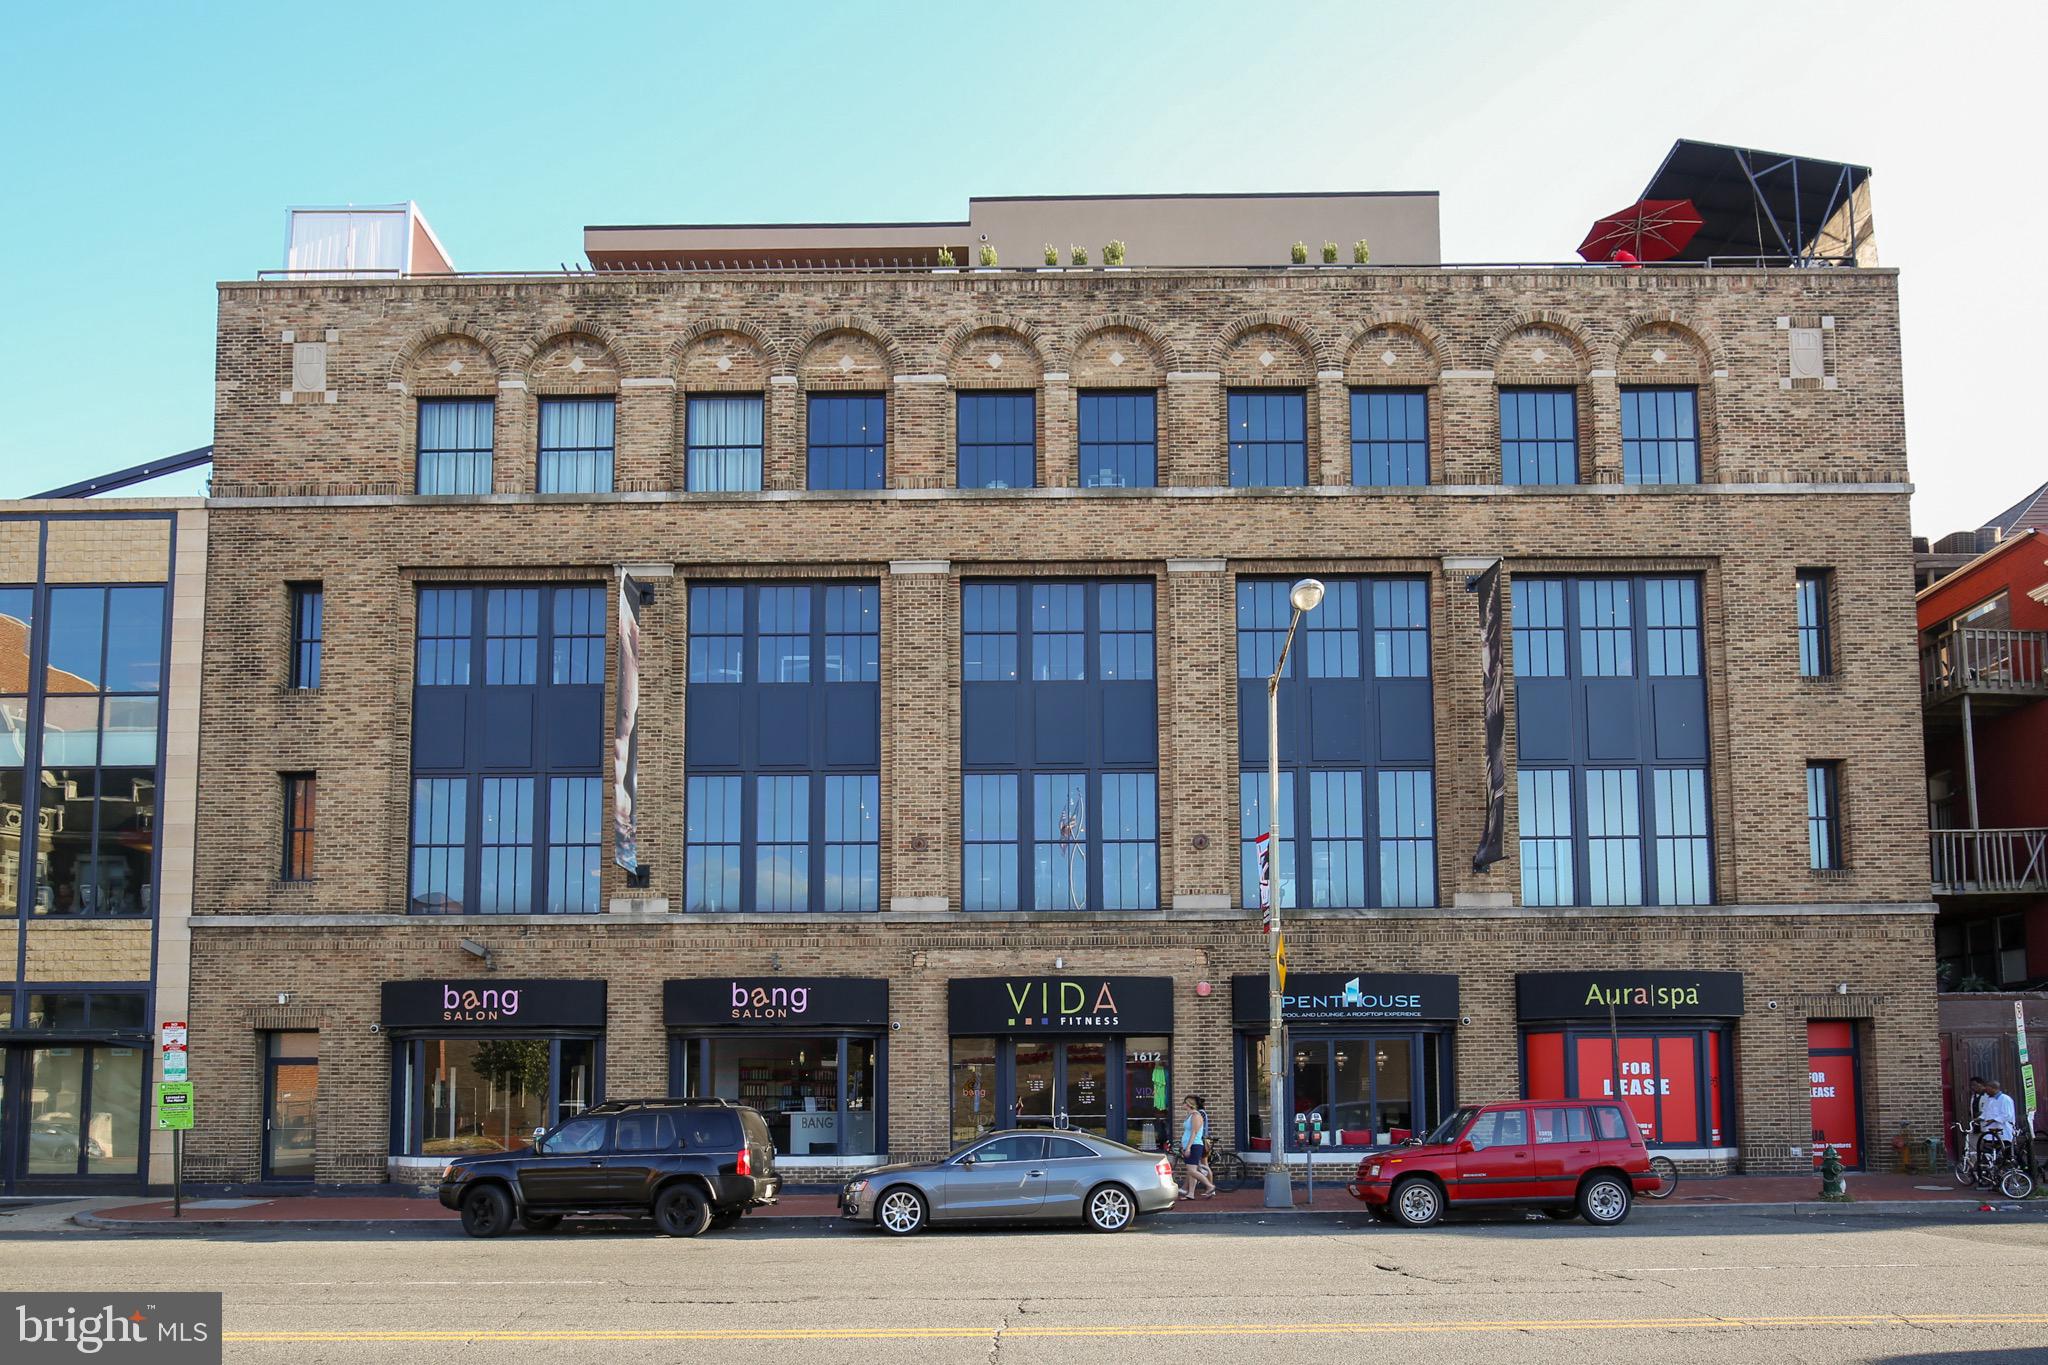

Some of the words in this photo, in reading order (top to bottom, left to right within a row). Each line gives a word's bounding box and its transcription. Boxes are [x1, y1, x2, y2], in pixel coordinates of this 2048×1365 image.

[444, 984, 519, 1016] bang
[732, 982, 808, 1014] bang
[1005, 981, 1118, 1015] VIDA
[1281, 991, 1422, 1008] PENTHOUSE
[443, 1011, 498, 1021] SALON
[731, 1008, 787, 1018] SALON
[1353, 1010, 1384, 1018] ROOFTOP
[1384, 1010, 1422, 1018] EXPERIENCE
[1060, 1016, 1119, 1026] FITNESS
[1133, 1051, 1161, 1062] 1612
[1622, 1062, 1651, 1075] FOR
[1603, 1078, 1671, 1095] LEASE
[801, 1116, 834, 1129] BANG
